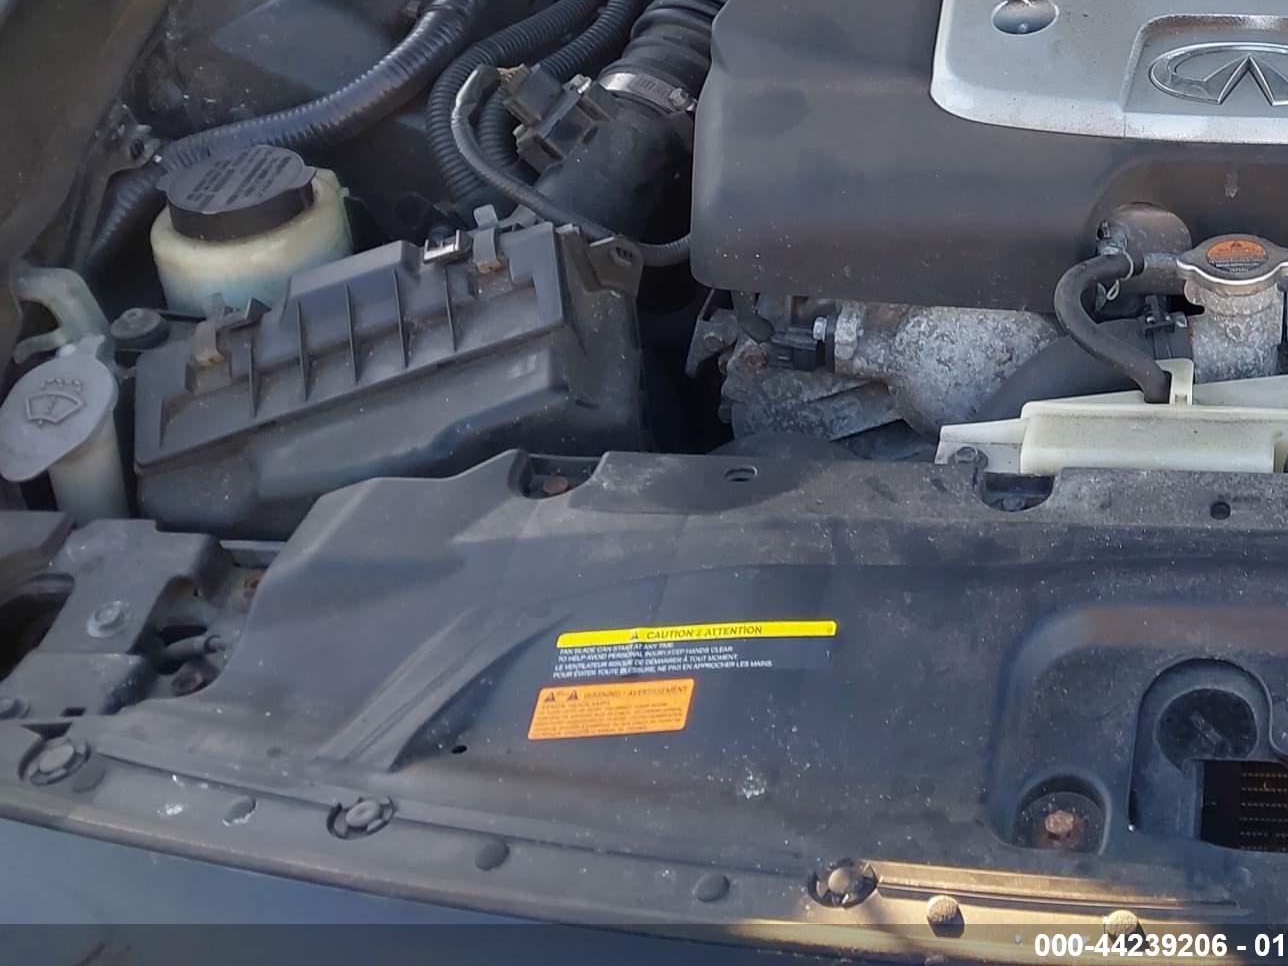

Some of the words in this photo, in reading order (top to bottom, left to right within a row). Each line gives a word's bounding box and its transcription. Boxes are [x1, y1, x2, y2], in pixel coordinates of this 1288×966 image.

[647, 628, 694, 640] CAUTION
[704, 625, 762, 637] ATTENTION
[568, 654, 585, 662] HELP
[587, 653, 607, 661] AVOID
[555, 664, 563, 672] LE
[565, 661, 607, 671] VENTILATEUR
[553, 671, 573, 679] POUR
[598, 667, 619, 675] TOUTE
